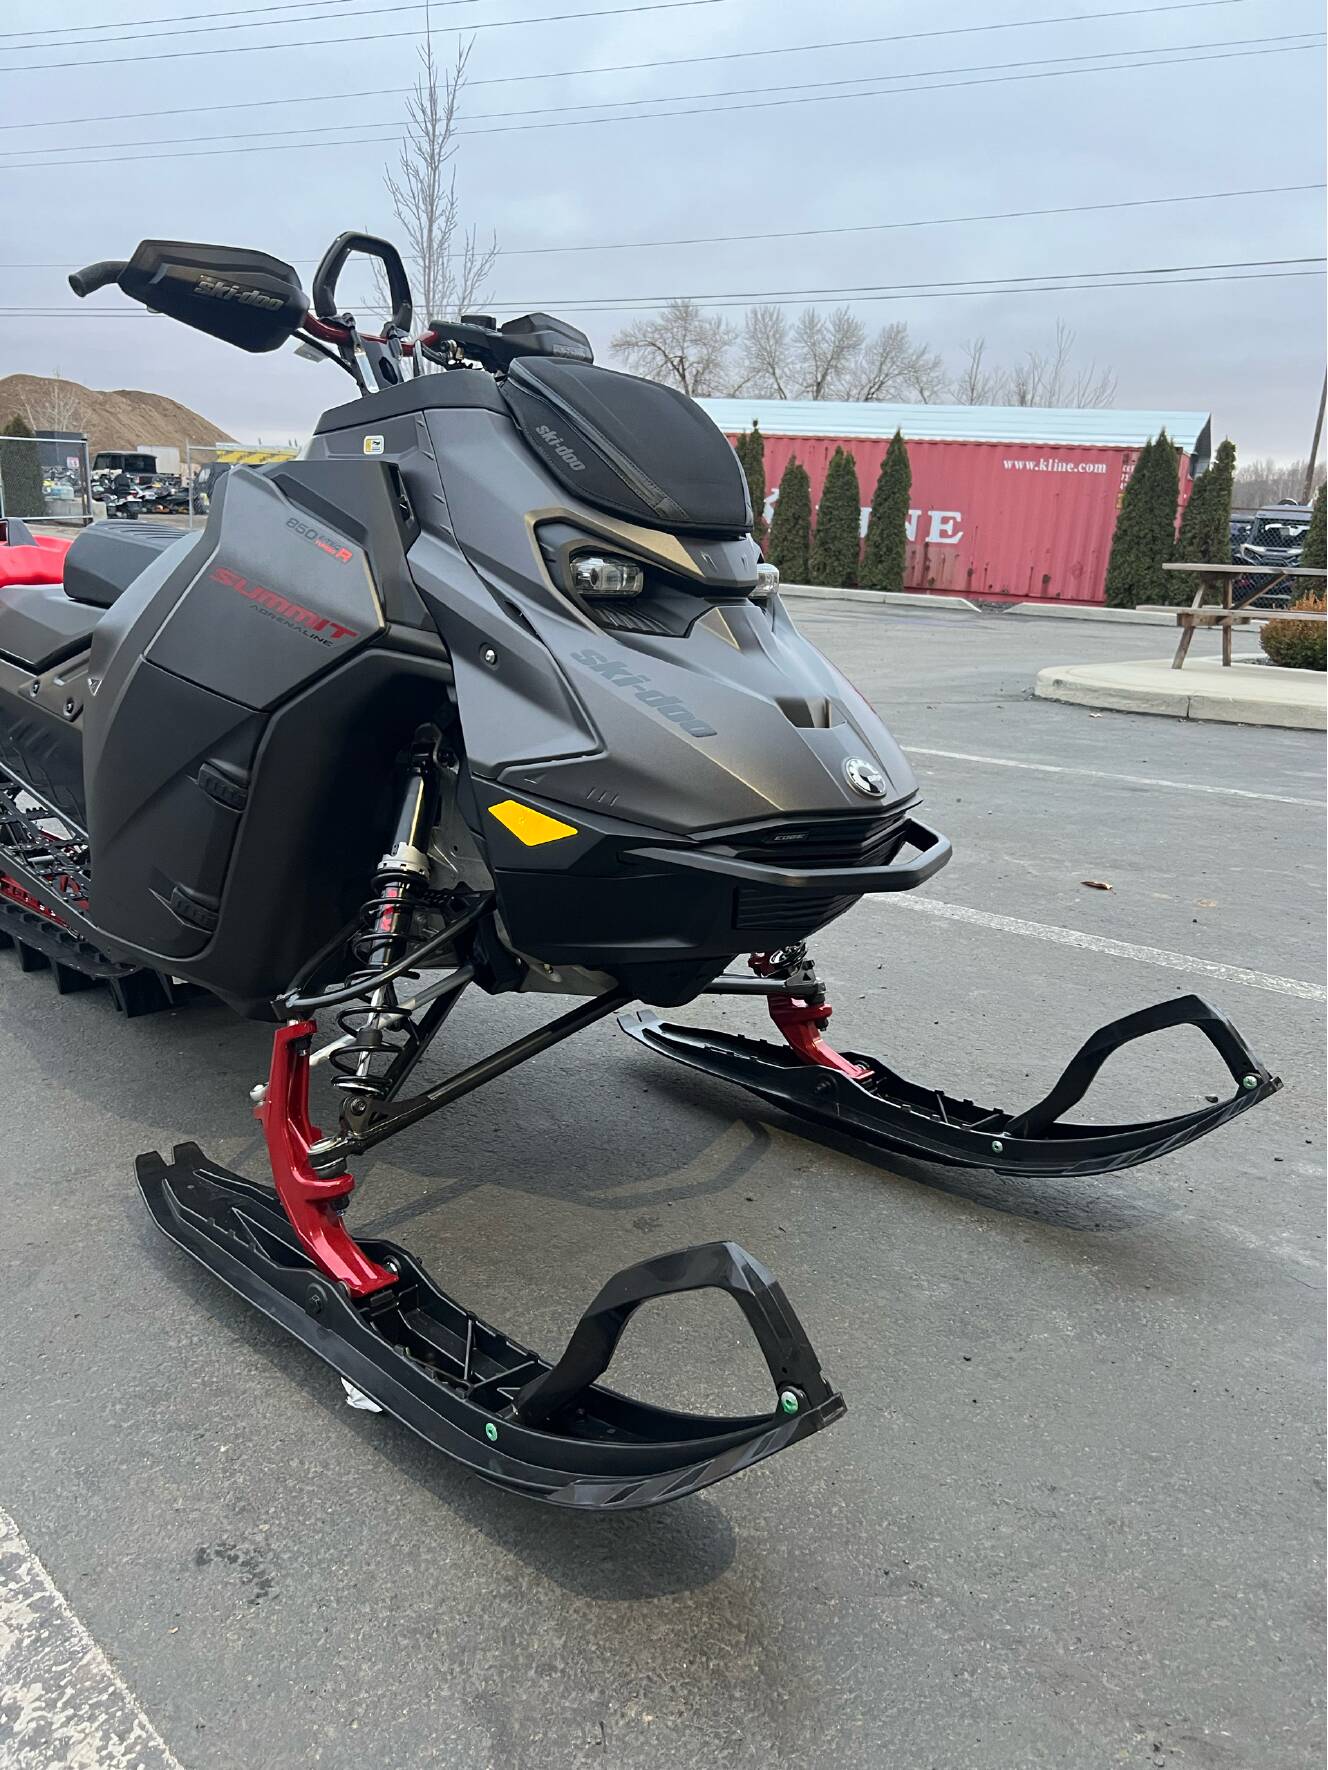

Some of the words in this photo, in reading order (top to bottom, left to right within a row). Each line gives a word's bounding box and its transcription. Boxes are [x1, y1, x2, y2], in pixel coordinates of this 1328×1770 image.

[1002, 458, 1107, 474] www.kline.com
[286, 517, 318, 540] 850
[208, 567, 360, 639] SUMMIT
[249, 603, 336, 649] ADRENALINE
